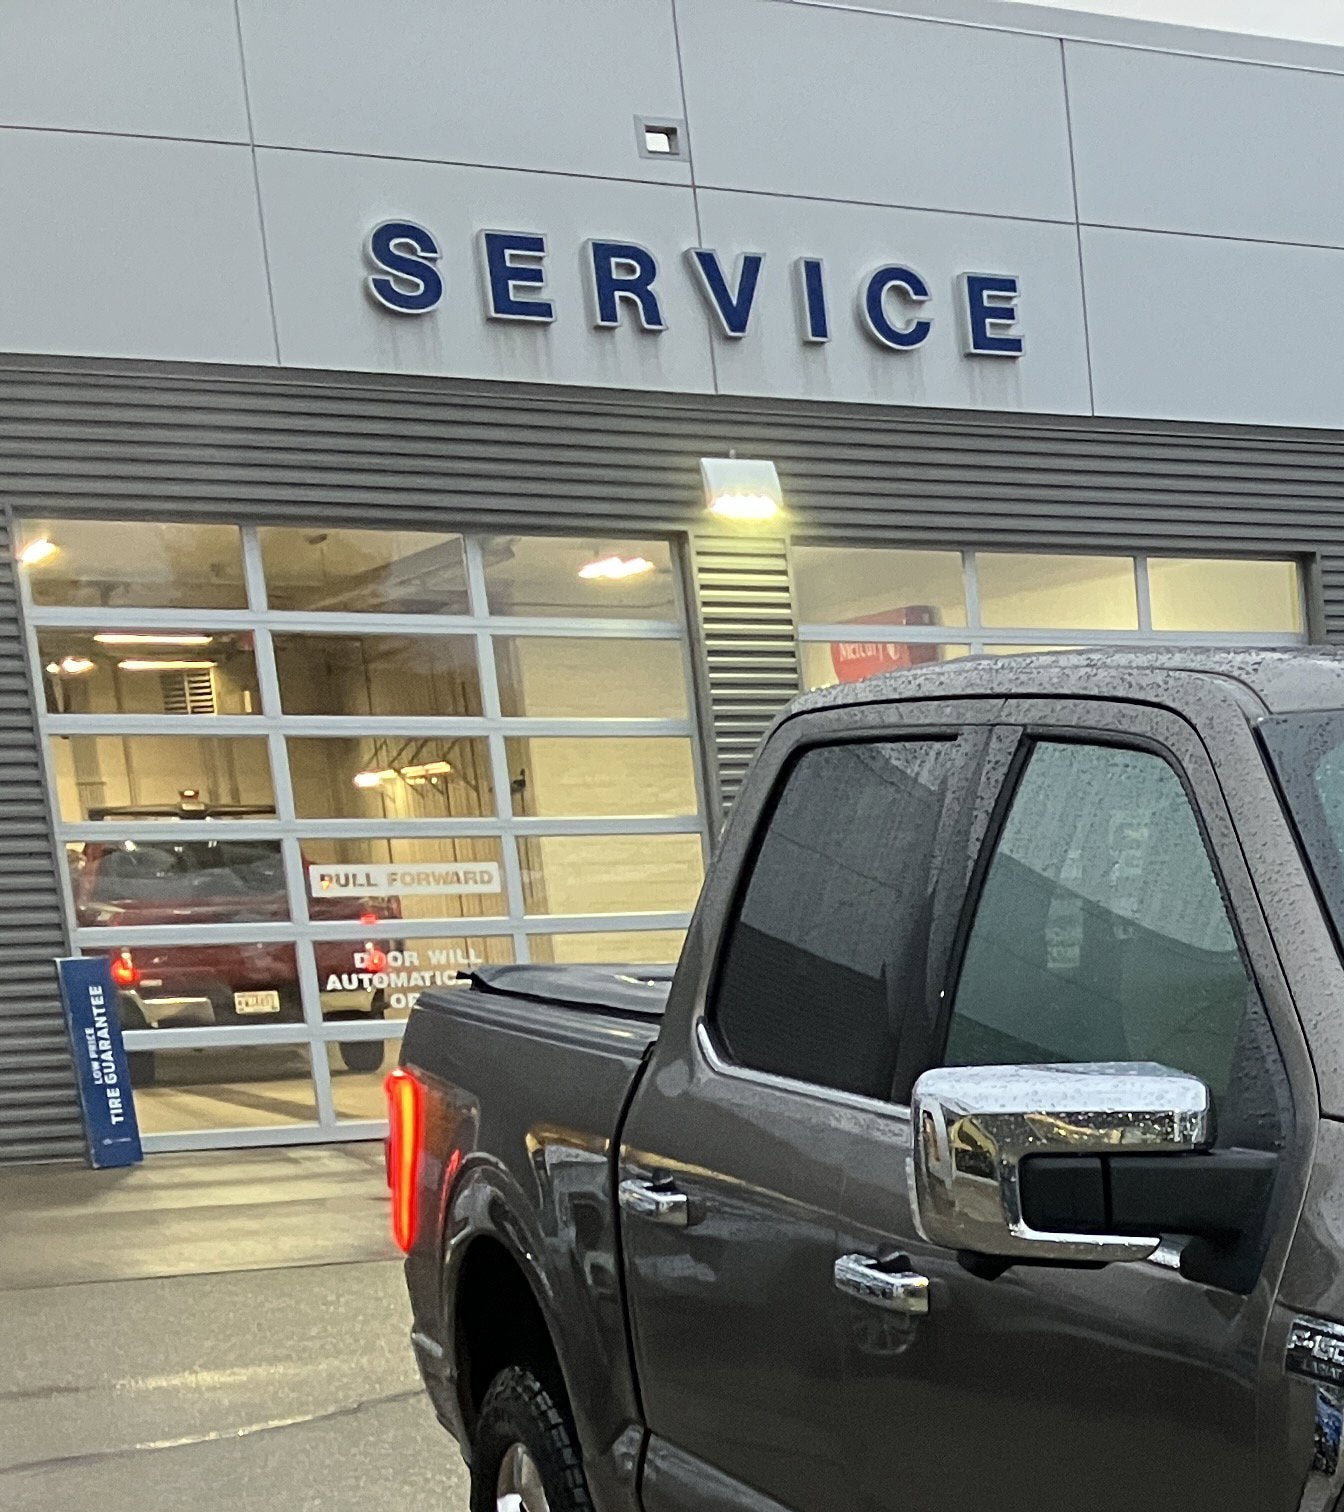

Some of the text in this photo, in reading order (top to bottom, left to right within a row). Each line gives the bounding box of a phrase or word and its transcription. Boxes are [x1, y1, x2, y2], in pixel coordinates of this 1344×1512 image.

[366, 218, 1026, 358] SERVICE
[319, 870, 494, 888] PULL FORWARD
[428, 948, 482, 965] WILL
[326, 970, 472, 991] AUTOMATIC
[88, 985, 118, 1085] GUARANTEE
[85, 1027, 104, 1085] LOW PRICE
[107, 1087, 124, 1125] TIRE
